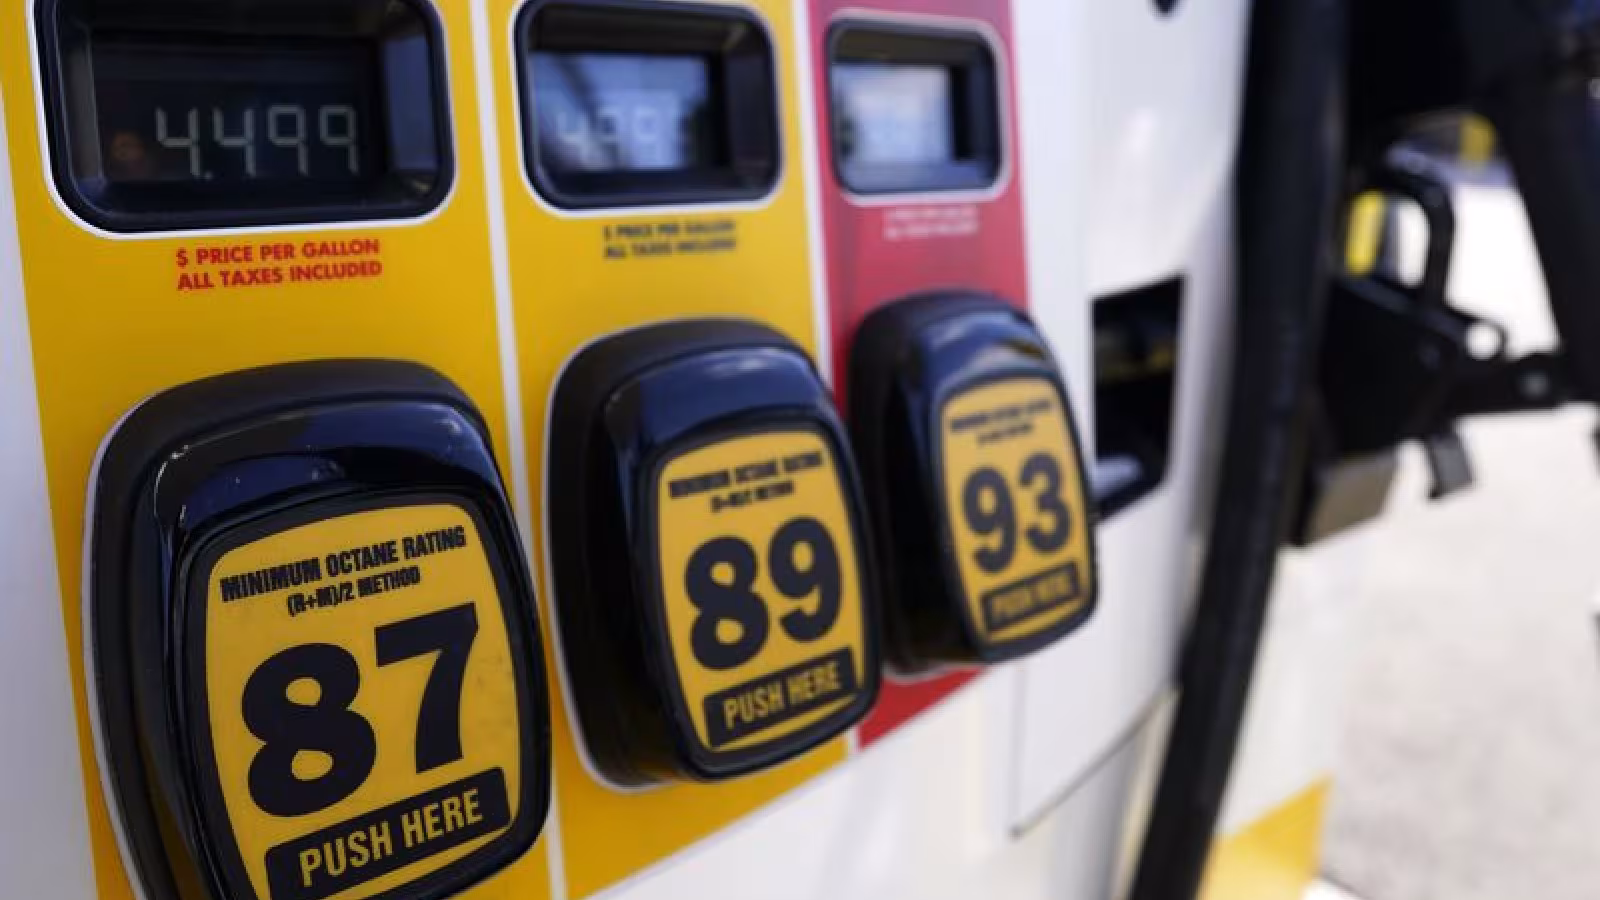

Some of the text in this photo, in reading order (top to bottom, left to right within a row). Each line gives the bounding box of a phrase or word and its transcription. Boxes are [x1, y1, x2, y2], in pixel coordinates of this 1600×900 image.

[155, 104, 360, 180] 4.499
[176, 238, 380, 269] $ PRICE PER GALLON
[177, 260, 383, 292] ALL TAXES INCLUDED
[963, 452, 1071, 574] 93
[220, 525, 467, 603] MINIMUM OCTANE RATING
[286, 565, 421, 617] (R+M)/2 METHOD
[684, 516, 843, 672] 89
[241, 601, 479, 818] 87
[723, 661, 841, 730] PUSH HERE
[299, 788, 483, 887] PUSH HERE
